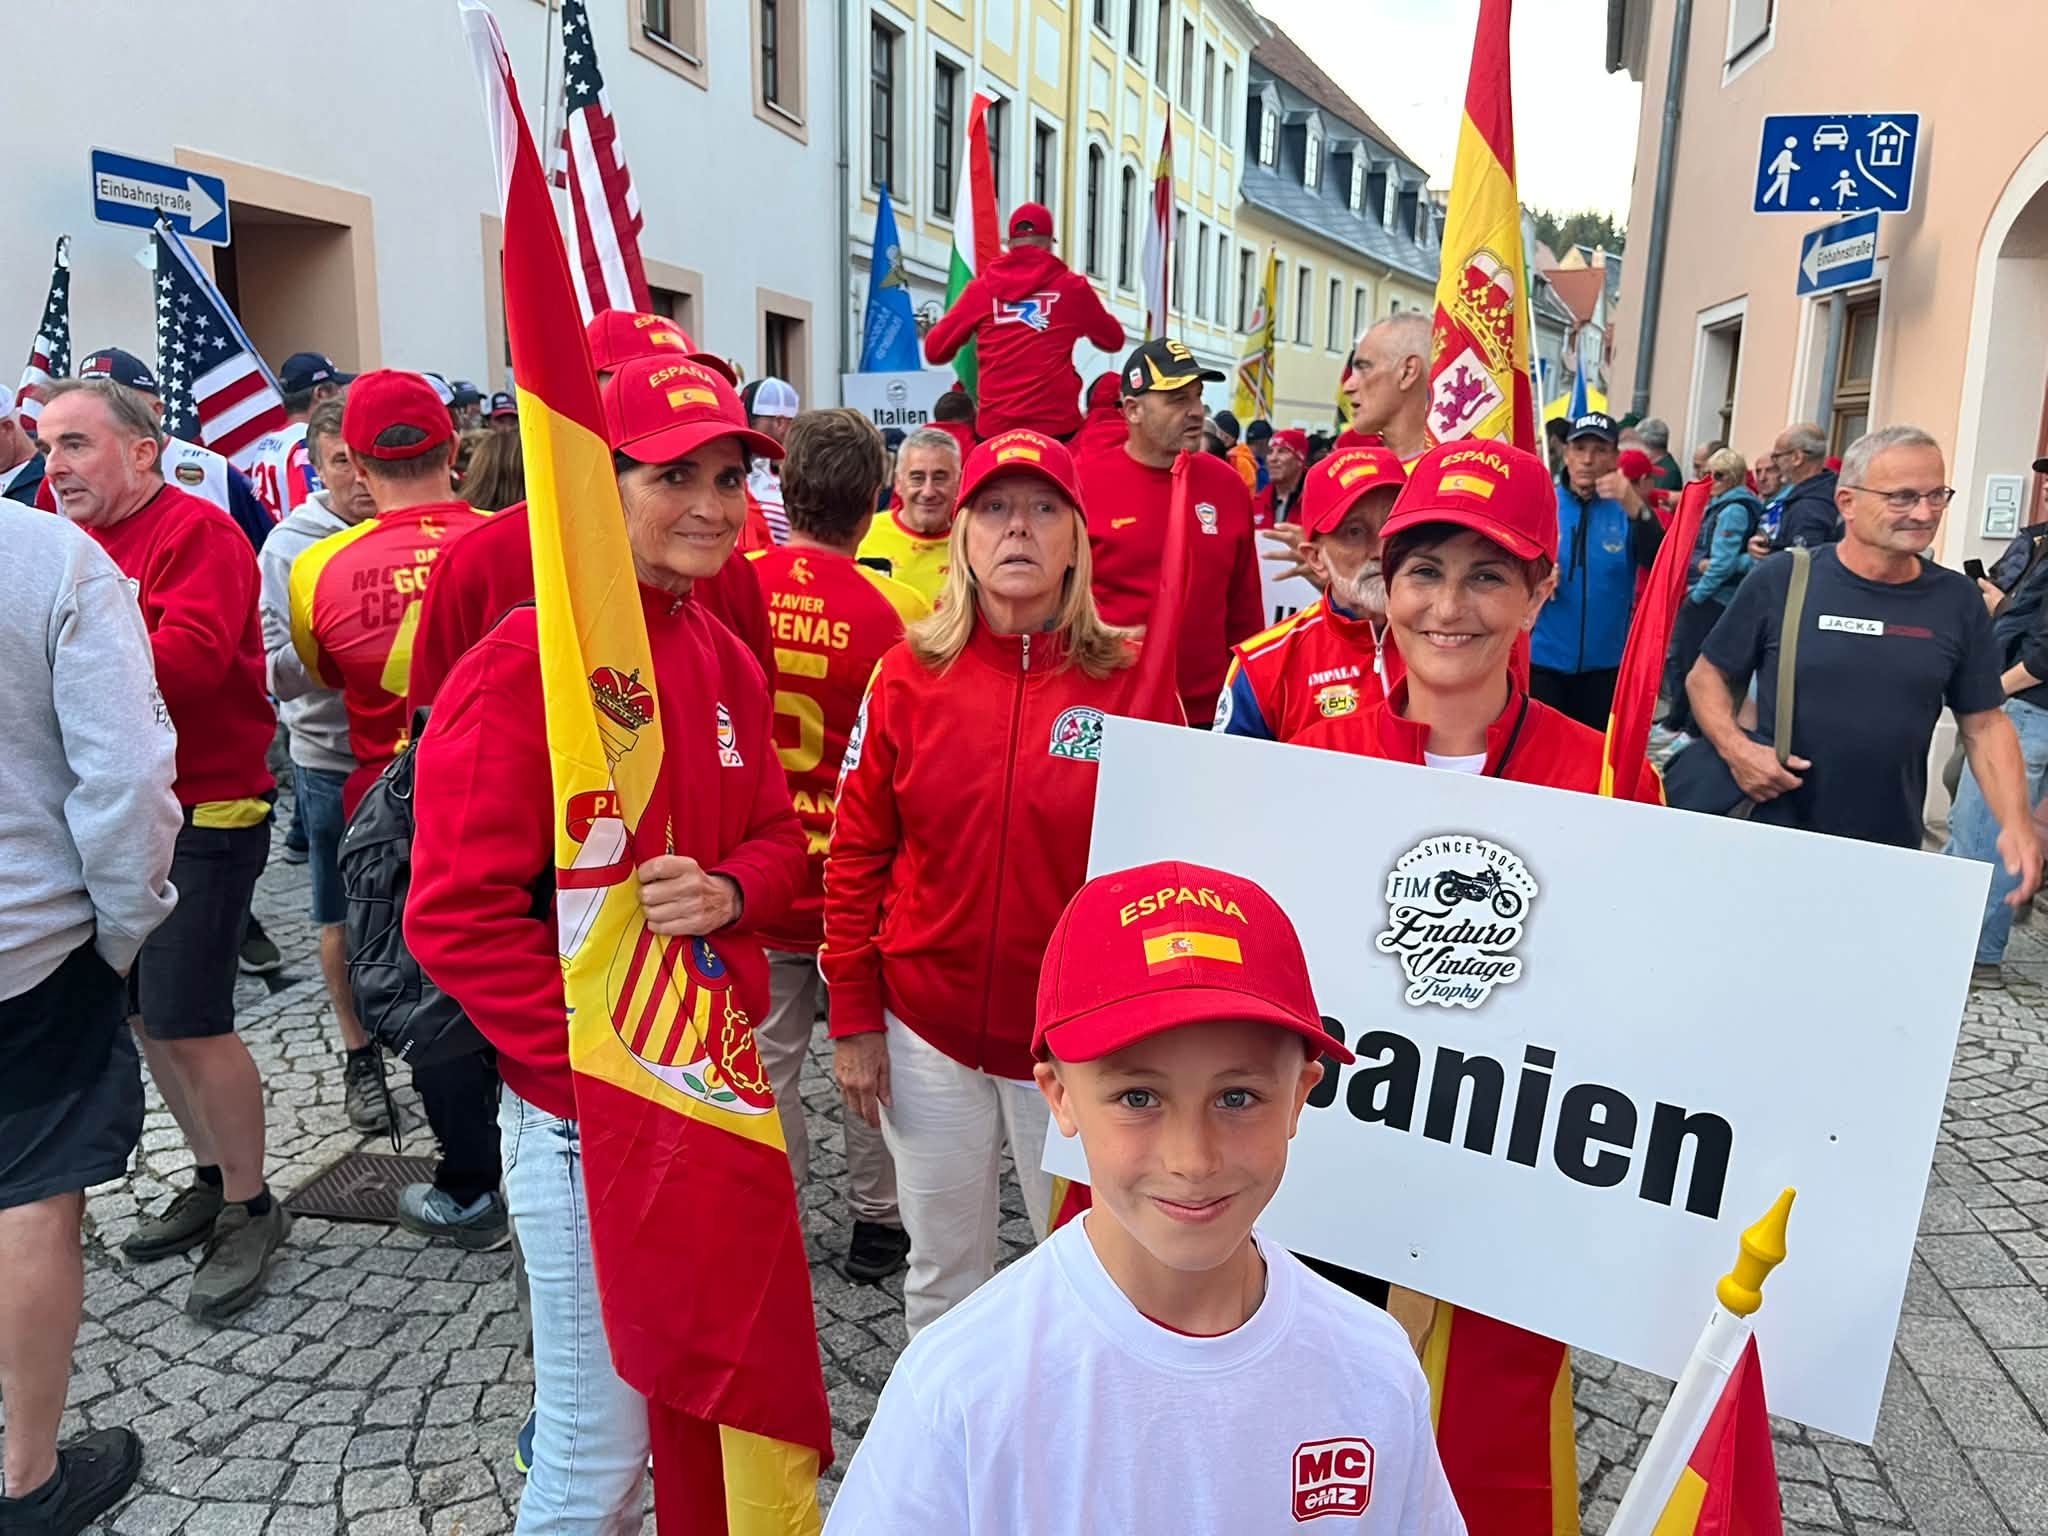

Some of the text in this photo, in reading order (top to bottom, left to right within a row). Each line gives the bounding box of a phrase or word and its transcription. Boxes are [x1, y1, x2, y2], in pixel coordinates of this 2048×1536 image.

[100, 178, 192, 212] Einbahnstraße
[1817, 239, 1871, 267] Einbahnstraße
[873, 407, 928, 425] Italien
[1440, 450, 1510, 480] ESPAÑA
[770, 591, 825, 614] XAVIER
[1308, 665, 1361, 687] IMPALA
[1051, 743, 1101, 761] APE
[594, 795, 621, 816] PL
[1424, 841, 1517, 873] SINCE 1904
[1391, 876, 1432, 899] FIM
[1119, 886, 1249, 928] ESPAÑA
[1381, 905, 1517, 951] Enduro
[1406, 945, 1517, 983] Vintage
[1411, 975, 1485, 1003] Trophy
[1299, 1447, 1367, 1486] MC
